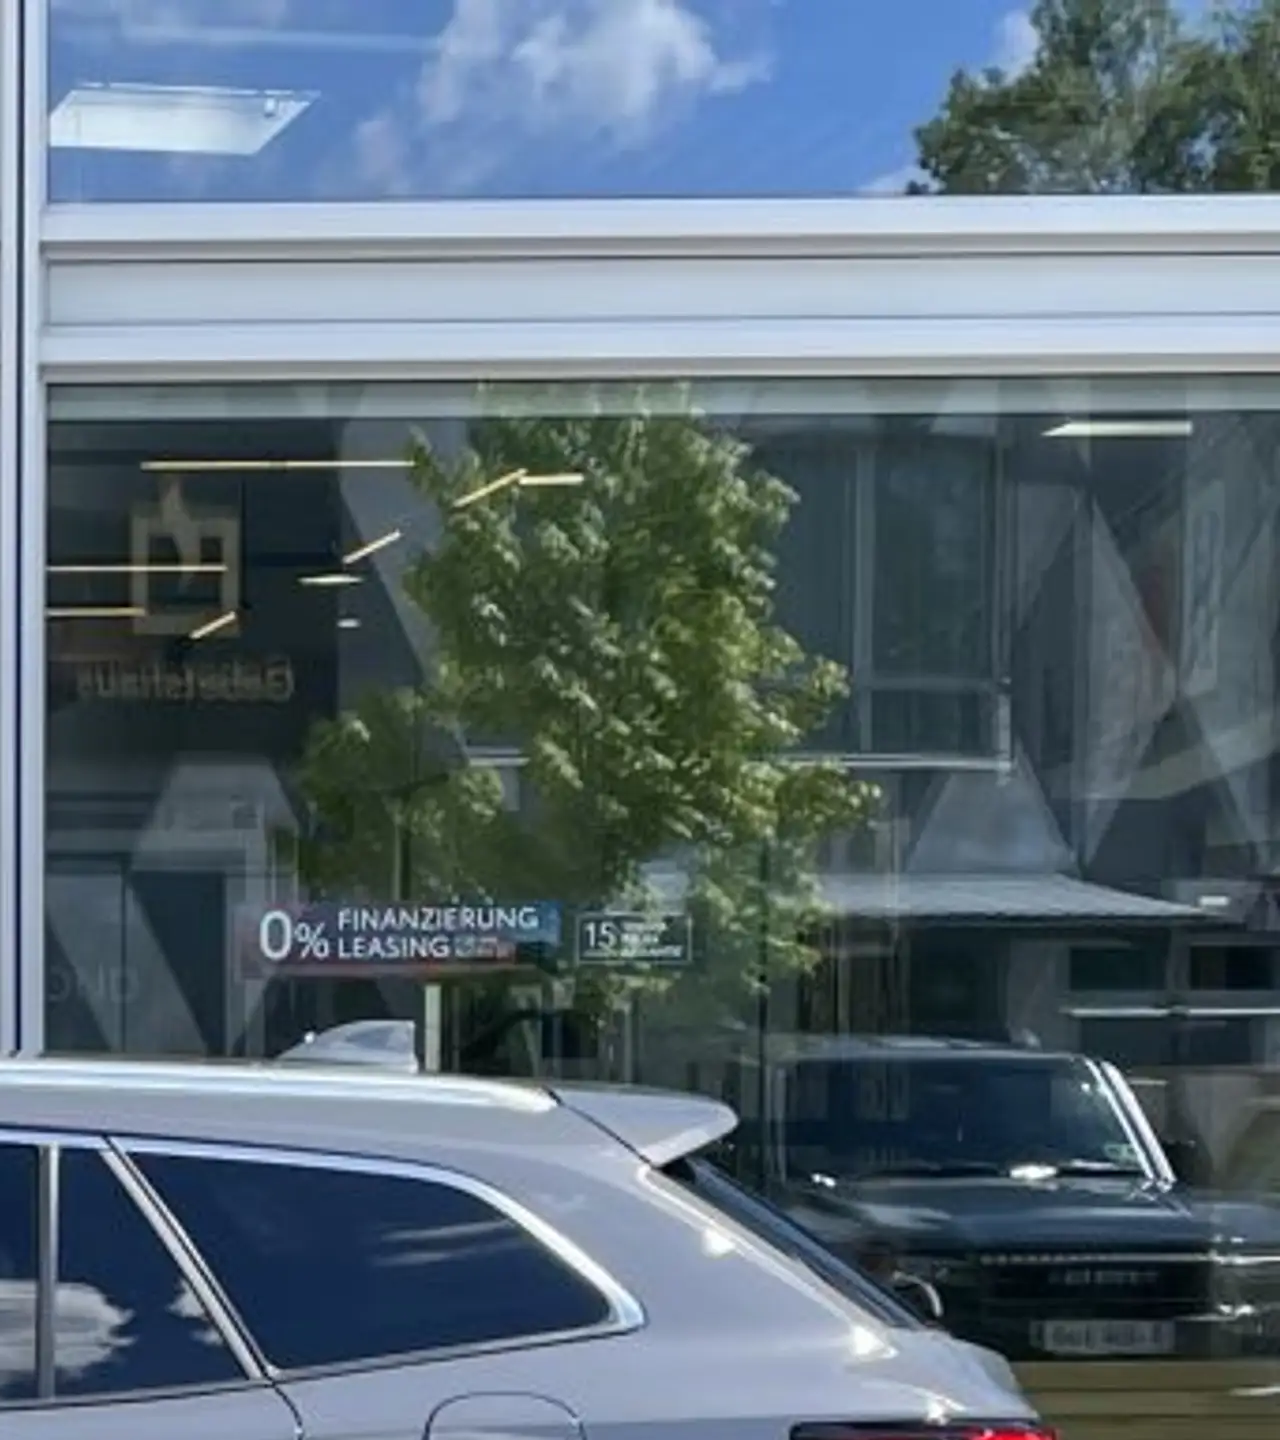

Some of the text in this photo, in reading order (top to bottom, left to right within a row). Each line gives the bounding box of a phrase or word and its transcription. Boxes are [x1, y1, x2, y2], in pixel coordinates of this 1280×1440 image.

[337, 907, 539, 931] FINANZIERUNG
[259, 910, 329, 962] 0%
[584, 921, 617, 948] 15
[337, 936, 449, 959] LEASING
